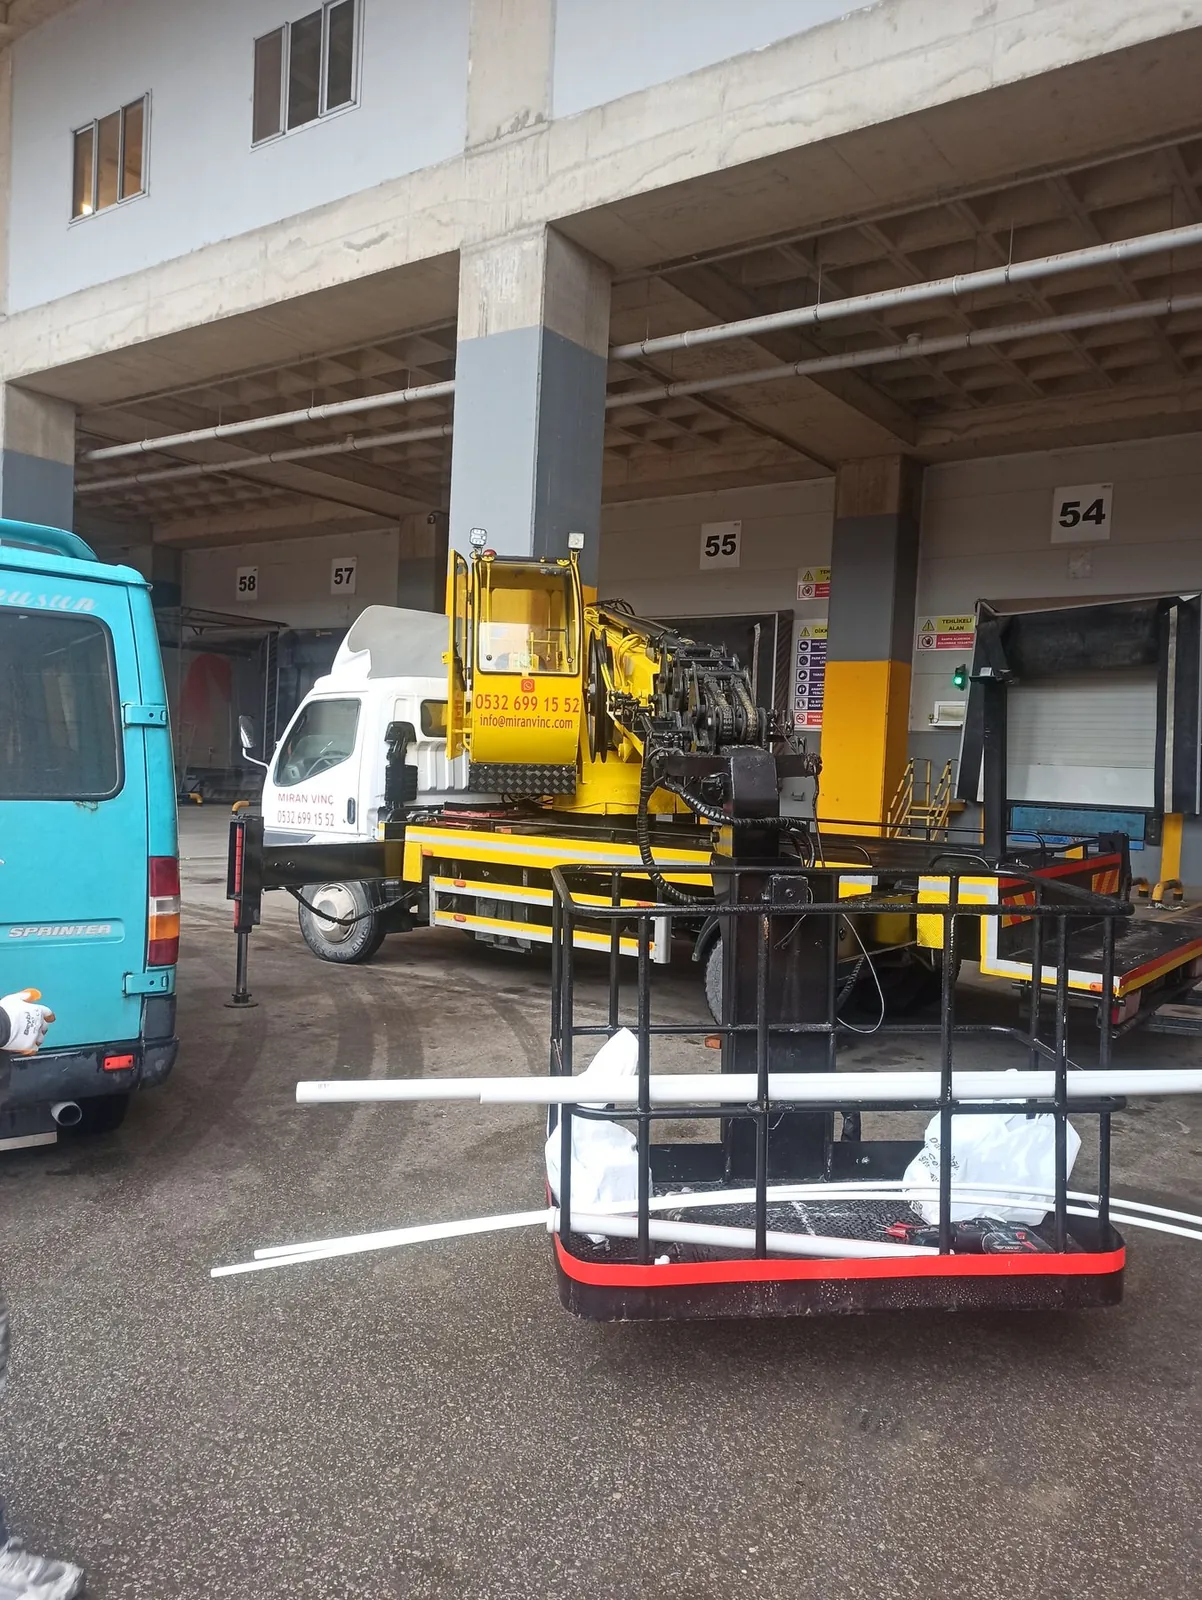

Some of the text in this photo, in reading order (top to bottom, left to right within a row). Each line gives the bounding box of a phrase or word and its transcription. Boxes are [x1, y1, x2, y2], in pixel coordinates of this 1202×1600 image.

[1058, 498, 1106, 528] 54
[704, 533, 737, 557] 55
[238, 575, 256, 592] 58
[333, 567, 354, 585] 57
[475, 693, 509, 711] 0532
[513, 695, 538, 711] 699
[544, 697, 559, 712] 15
[564, 697, 580, 713] 52
[479, 713, 573, 729] info@miranvinc.com
[278, 793, 334, 805] MIRAN VINÇ
[277, 810, 335, 827] 0532 699 15 52
[9, 924, 112, 937] SPRINTER
